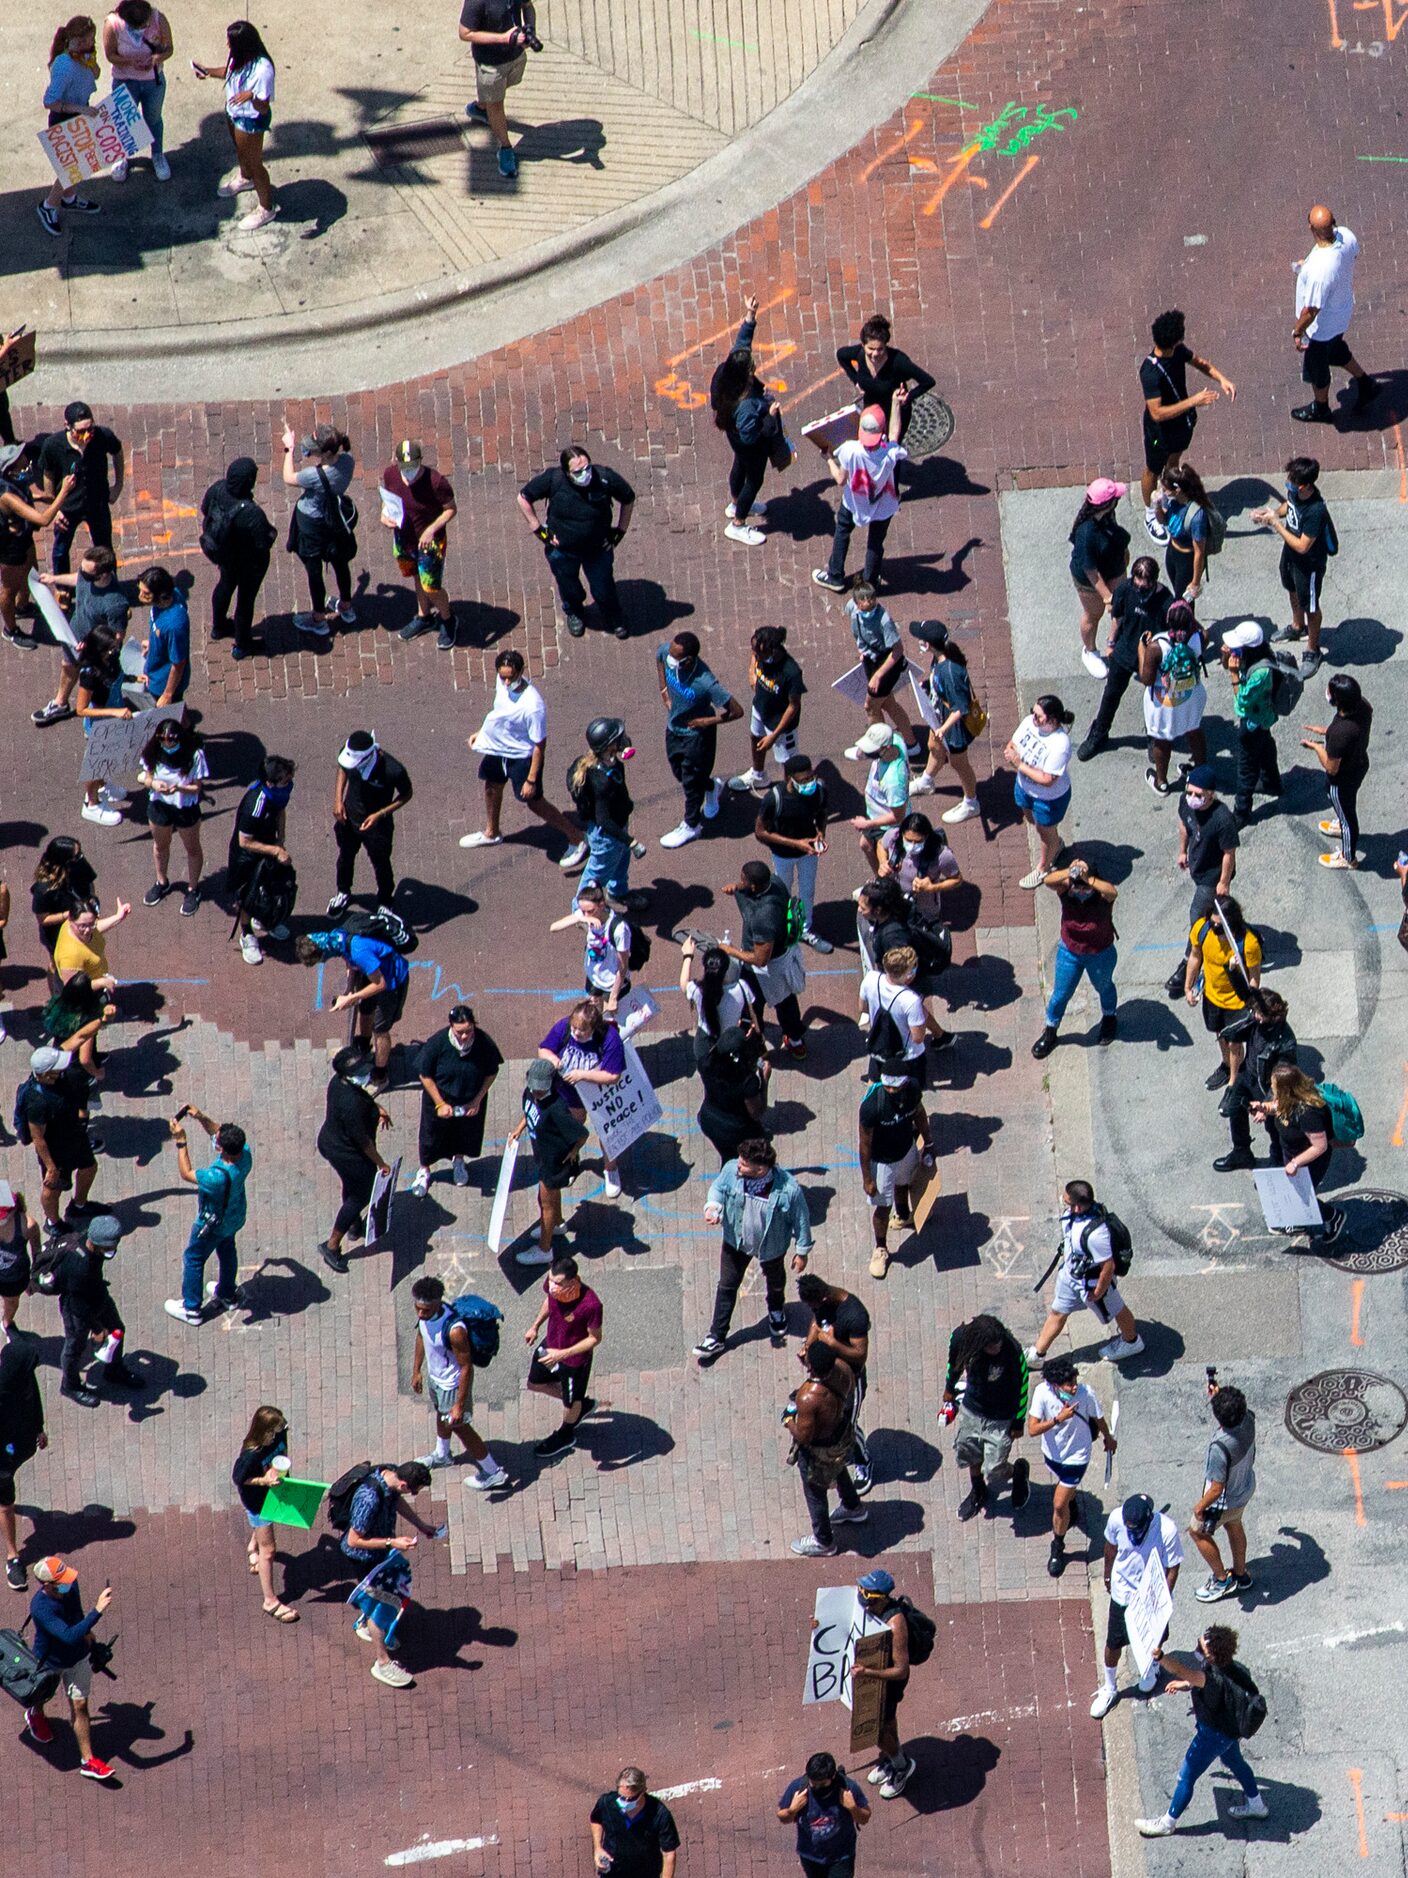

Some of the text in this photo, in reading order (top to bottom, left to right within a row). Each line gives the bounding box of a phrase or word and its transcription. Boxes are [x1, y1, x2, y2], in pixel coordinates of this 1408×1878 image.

[111, 86, 141, 127] MORE
[45, 124, 78, 170] RACIST
[66, 117, 96, 153] STOP
[95, 104, 125, 164] FOR COPS
[110, 107, 139, 157] TRAINING
[605, 1096, 624, 1116] NO
